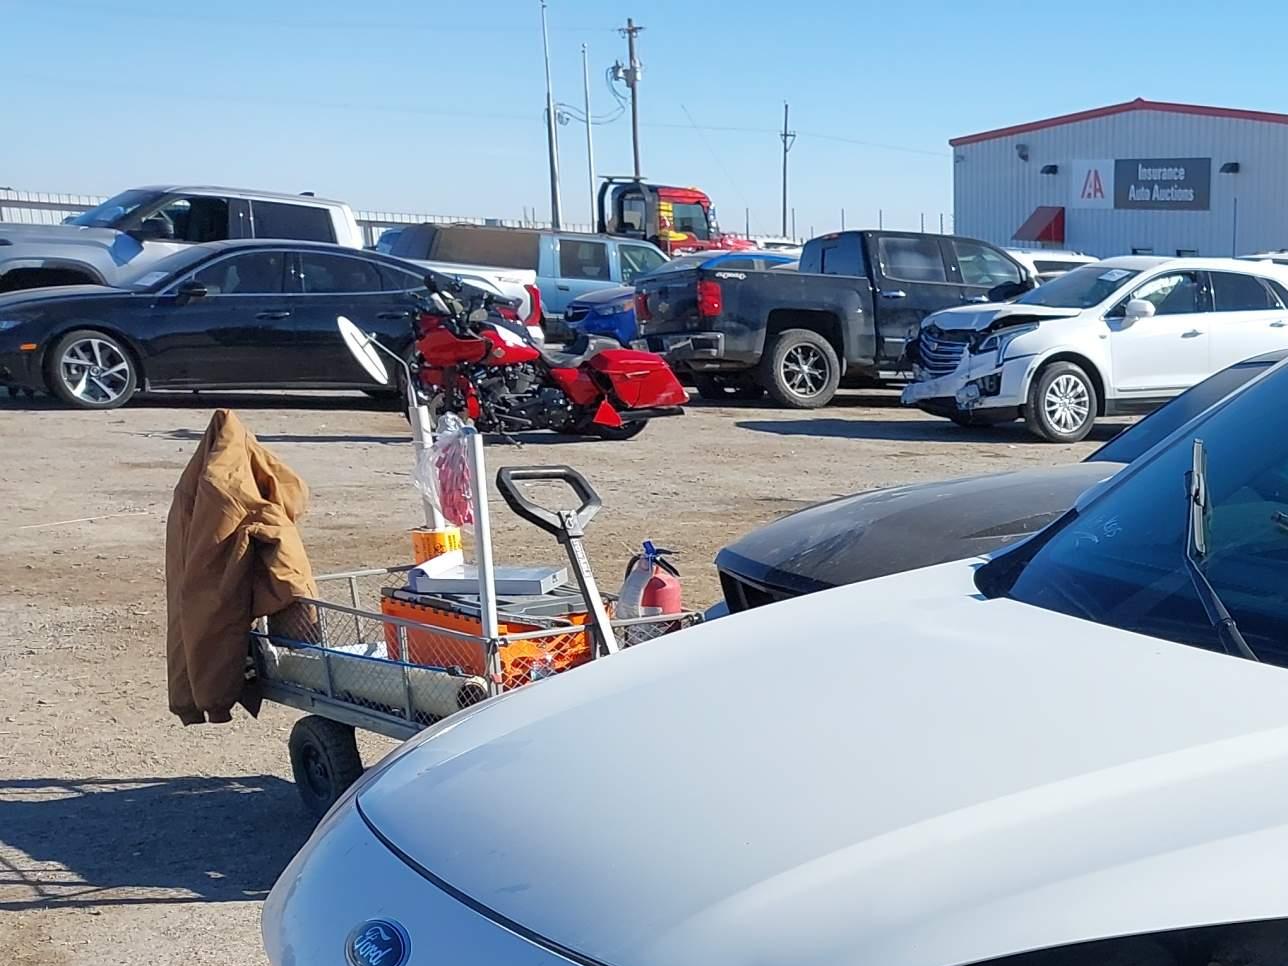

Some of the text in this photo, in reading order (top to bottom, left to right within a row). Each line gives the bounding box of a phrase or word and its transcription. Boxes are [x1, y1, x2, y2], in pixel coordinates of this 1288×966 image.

[1138, 163, 1185, 180] Insurance
[1128, 184, 1194, 202] Auto Auctions
[354, 926, 393, 966] Ford
